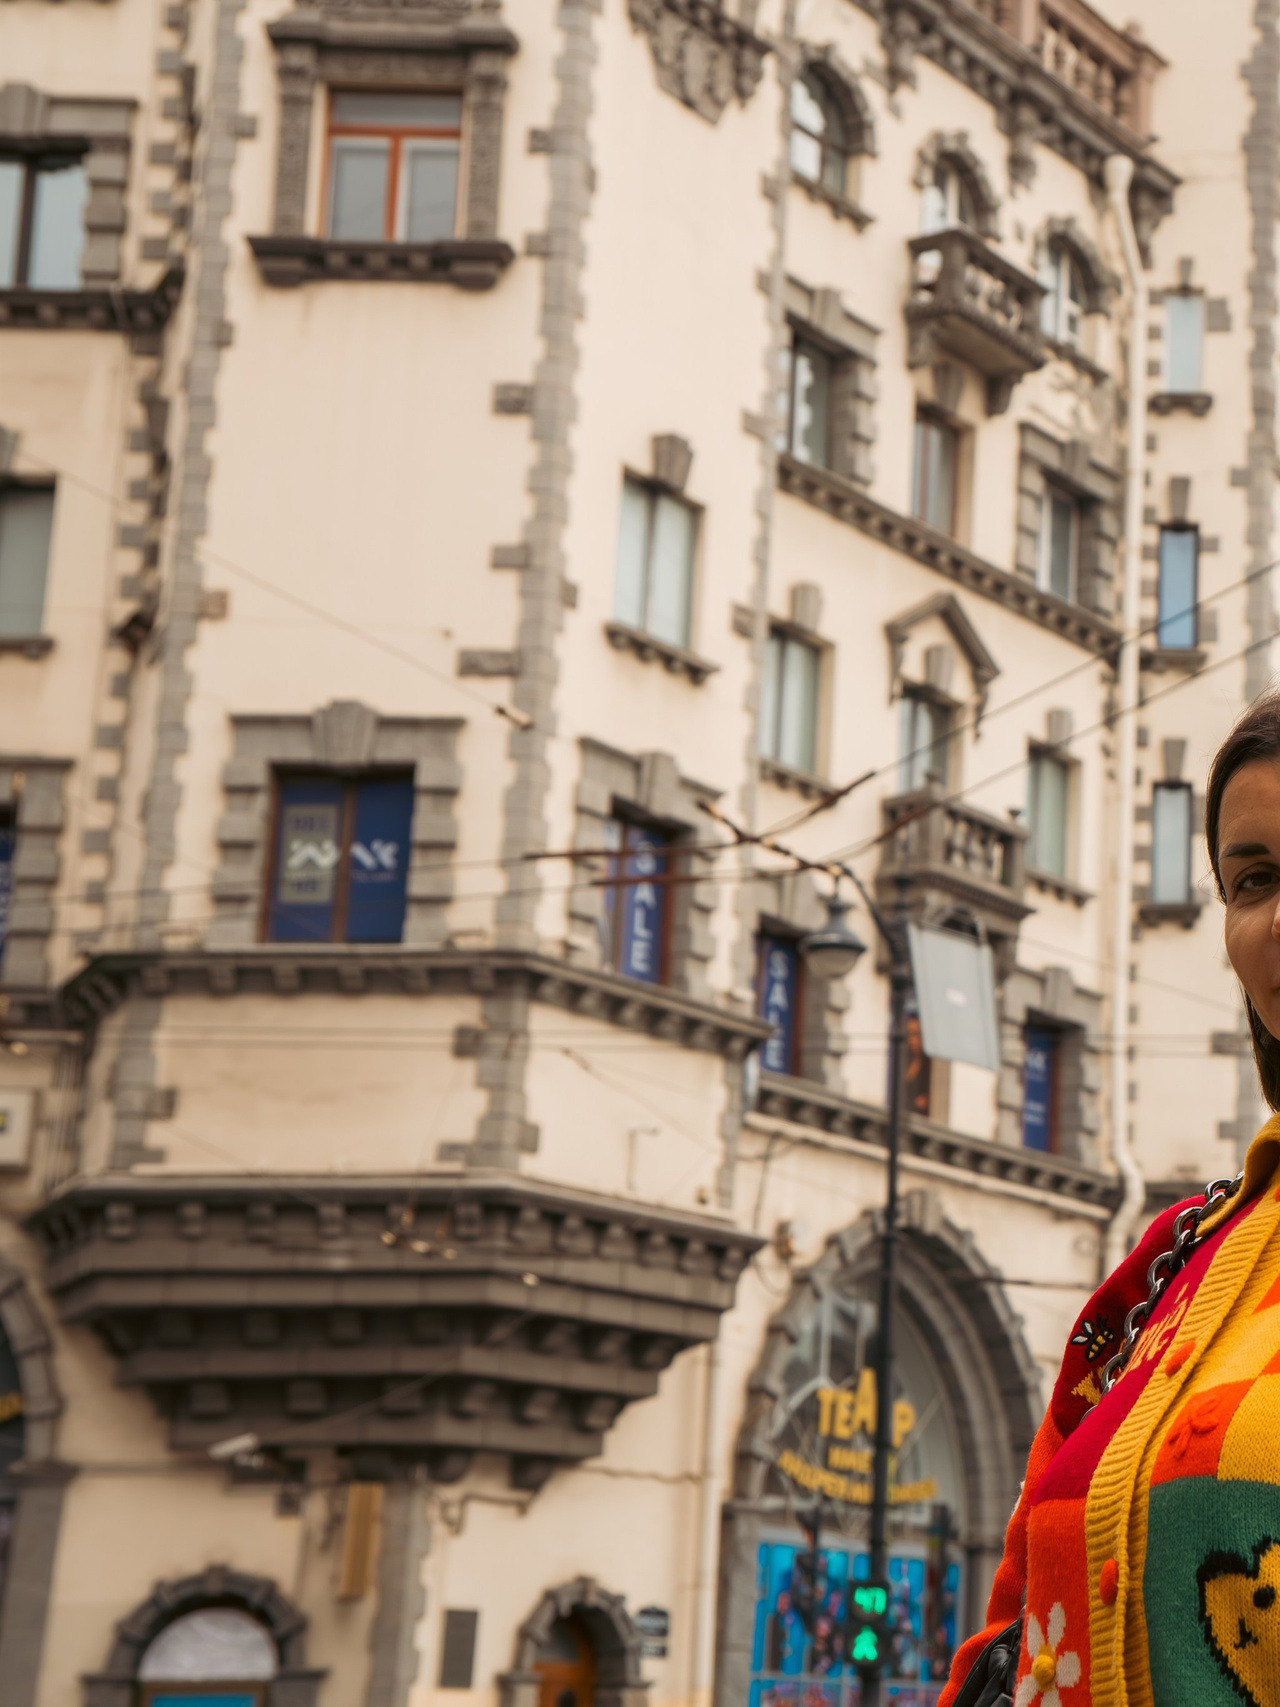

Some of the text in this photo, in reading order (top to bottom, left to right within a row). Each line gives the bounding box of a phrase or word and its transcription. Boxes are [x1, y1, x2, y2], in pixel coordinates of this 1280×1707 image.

[631, 841, 656, 973] SALE
[765, 950, 789, 1069] SALE
[816, 1367, 916, 1448] ТЕАР
